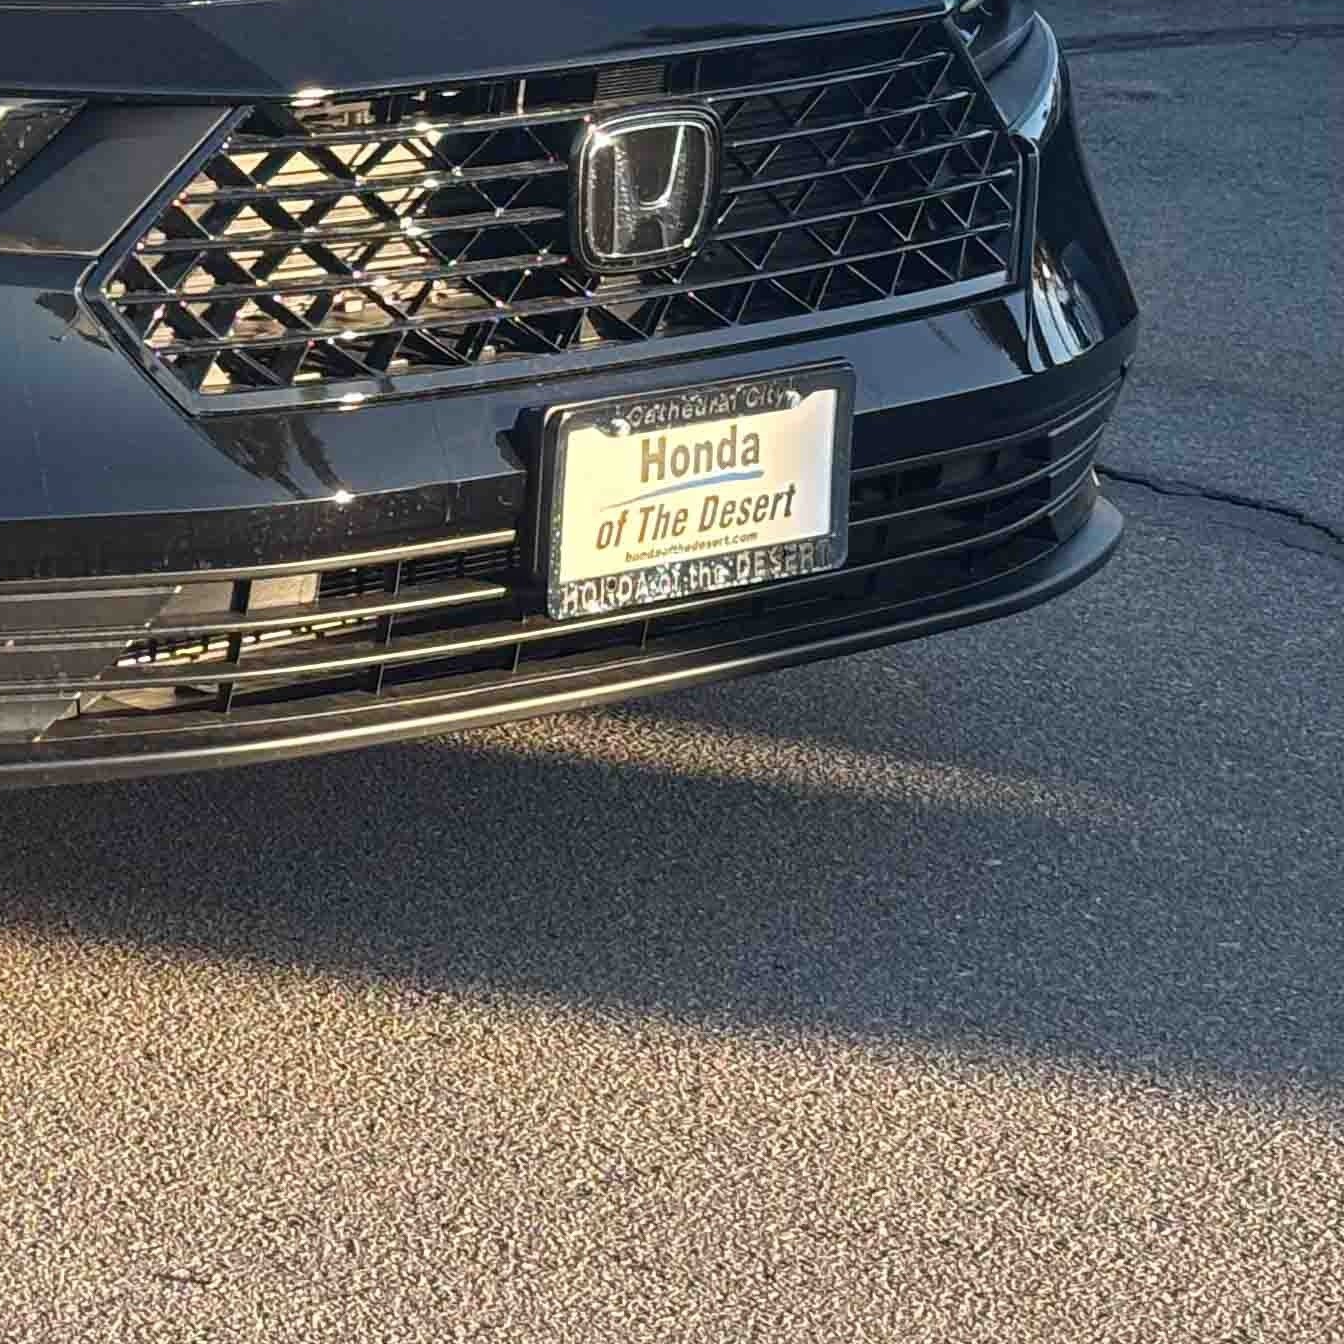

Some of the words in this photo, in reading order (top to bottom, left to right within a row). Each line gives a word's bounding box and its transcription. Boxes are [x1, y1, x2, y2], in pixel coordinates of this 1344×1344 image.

[627, 391, 738, 428] Cathedral
[745, 384, 785, 408] City
[640, 424, 761, 483] Honda
[596, 510, 629, 551] of
[638, 504, 689, 544] The
[698, 482, 796, 532] Desert
[736, 539, 832, 580] DESERT
